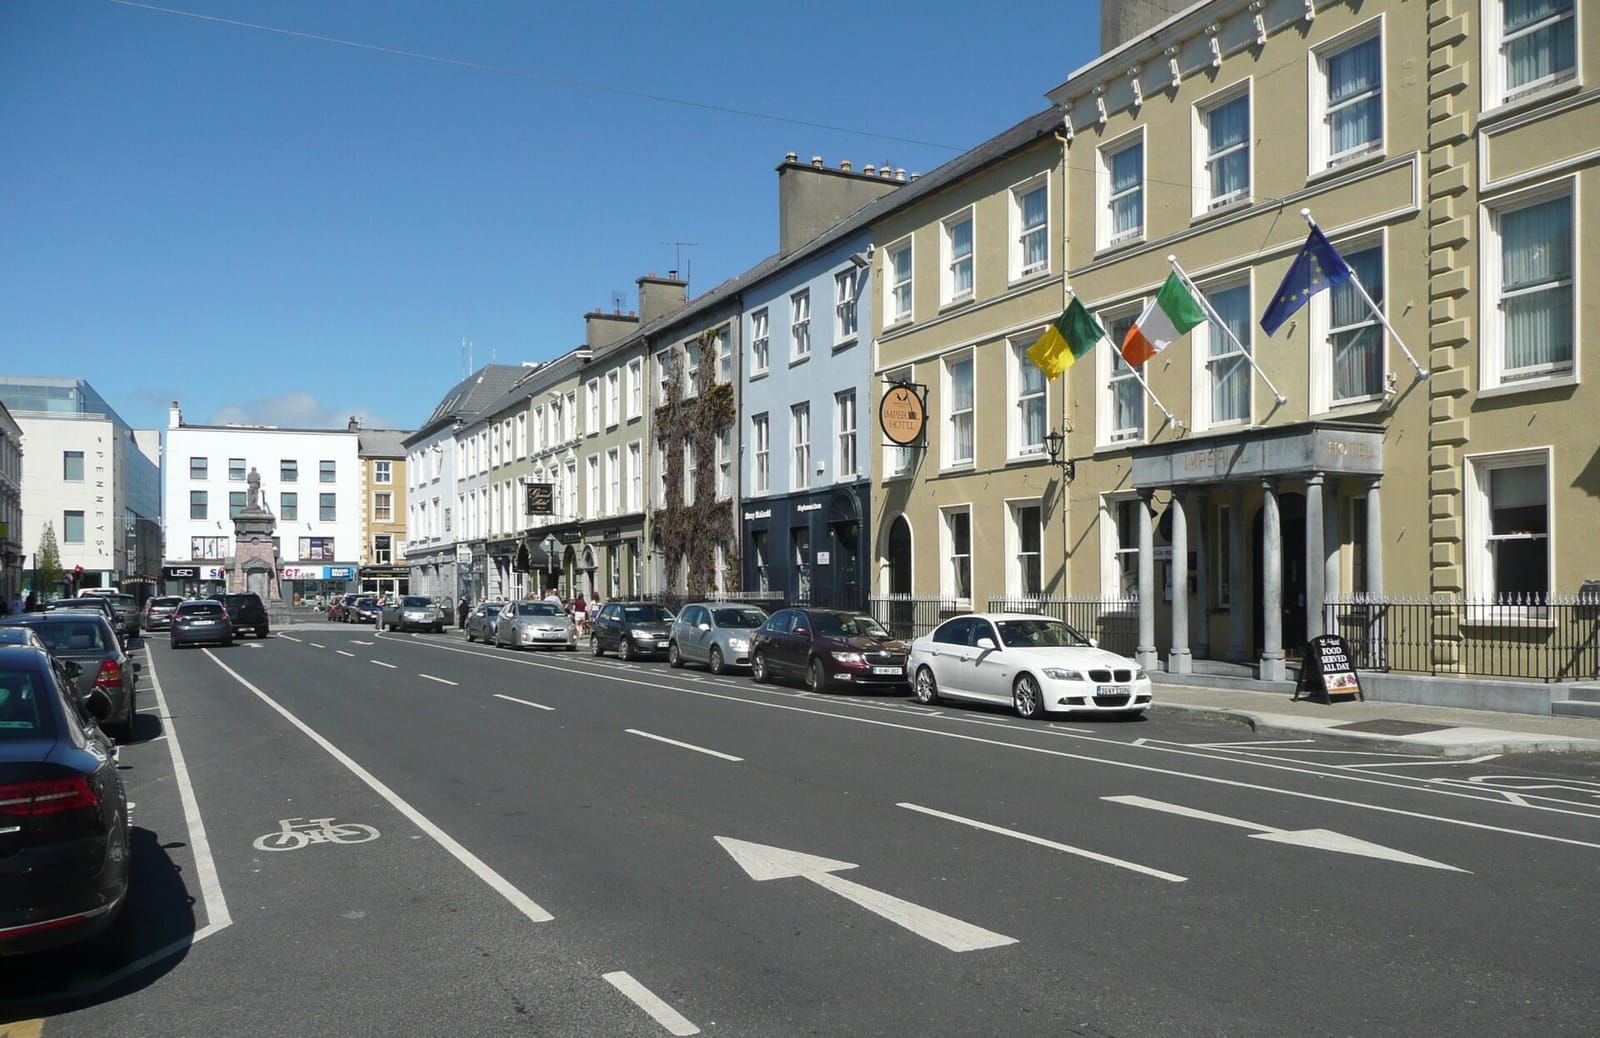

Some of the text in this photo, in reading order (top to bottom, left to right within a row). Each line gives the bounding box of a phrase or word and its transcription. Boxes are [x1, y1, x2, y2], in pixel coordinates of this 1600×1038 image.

[1328, 441, 1375, 459] HOTEL
[96, 451, 104, 546] PENNEYS
[1321, 647, 1342, 655] FOOD
[1321, 655, 1347, 663] SERVED
[1323, 662, 1350, 672] ALL DAY
